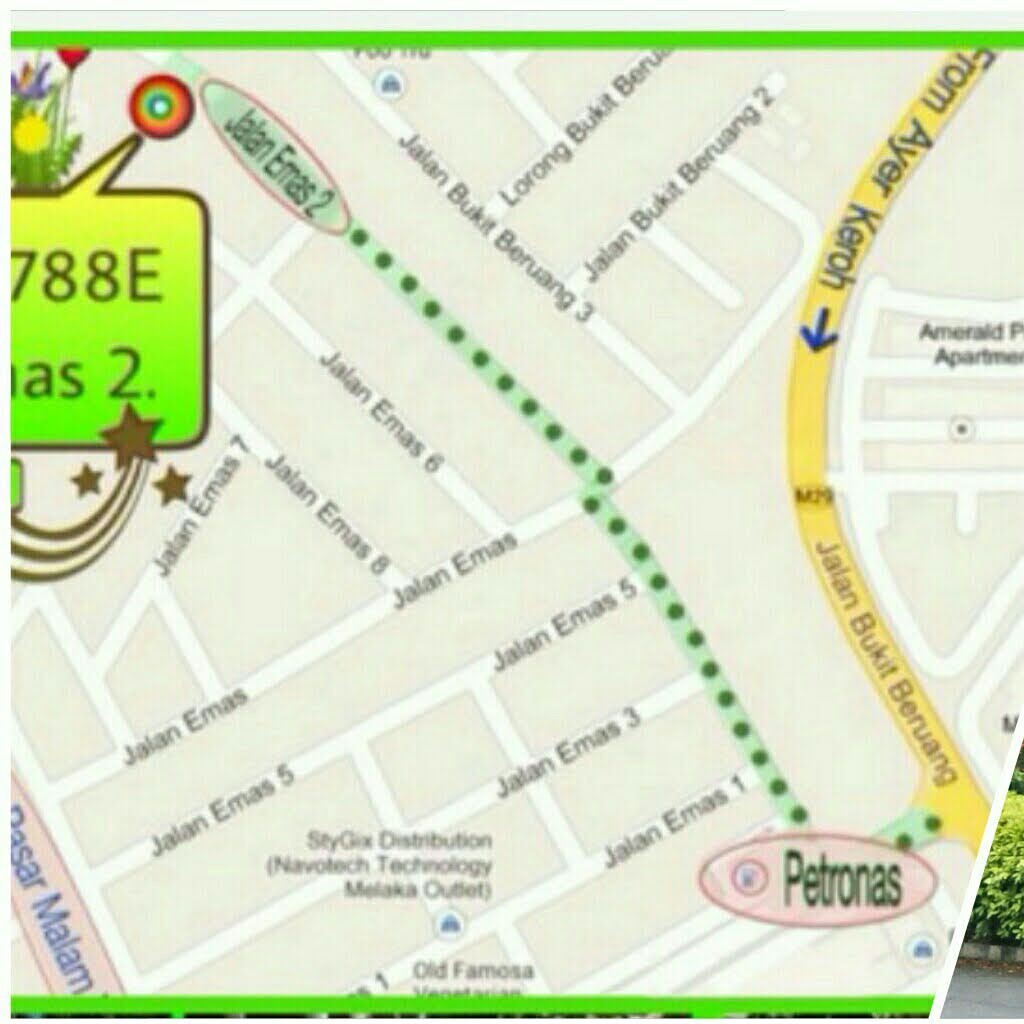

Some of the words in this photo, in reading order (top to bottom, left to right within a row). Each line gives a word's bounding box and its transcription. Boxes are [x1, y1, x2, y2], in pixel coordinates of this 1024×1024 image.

[225, 109, 275, 164] Jalan
[264, 144, 317, 210] Emas
[305, 190, 335, 218] 2
[498, 142, 573, 207] Lorong
[566, 92, 620, 146] Bukit
[583, 227, 635, 283] Jalan
[629, 179, 684, 232] Bukit
[678, 104, 762, 186] Beruang
[753, 86, 775, 108] 2
[872, 118, 934, 199] Ayer
[399, 134, 449, 188] Jalan
[447, 182, 497, 237] Bukit
[494, 228, 577, 313] Beruang
[576, 302, 594, 323] 3
[820, 203, 882, 290] Keroh
[109, 346, 155, 399] 2.
[319, 351, 373, 405] Jalan
[369, 398, 427, 458] Emas
[424, 453, 445, 474] 6
[152, 518, 200, 577] Jalan
[188, 455, 241, 518] Emas
[230, 433, 252, 454] 7
[265, 454, 319, 508] Jalan
[317, 501, 372, 560] Emas
[370, 554, 392, 576] 8
[393, 568, 451, 611] Jalan
[450, 531, 519, 577] Emas
[494, 628, 551, 673] Jalan
[551, 592, 618, 638] Emas
[618, 577, 638, 601] 5
[815, 539, 857, 610] Jalan
[850, 612, 899, 682] Bukit
[888, 678, 959, 788] Beruang
[123, 725, 182, 766] Jalan
[182, 689, 249, 733] Emas
[496, 756, 555, 799] Jalan
[554, 720, 622, 766] Emas
[623, 706, 642, 729] 3
[150, 814, 210, 858] Jalan
[209, 778, 275, 824] Emas
[276, 762, 295, 787] 5
[378, 831, 492, 849] Distribution
[604, 824, 663, 869] Jalan
[661, 788, 729, 836] Emas
[731, 775, 747, 794] 1
[266, 857, 369, 876] (Navotech
[376, 857, 492, 876] Technology
[344, 881, 417, 898] Melaka
[424, 881, 492, 900] Outlet)
[784, 849, 902, 908] Petronas
[31, 891, 93, 994] Malam
[412, 961, 448, 980] Old
[453, 961, 535, 980] Famosa
